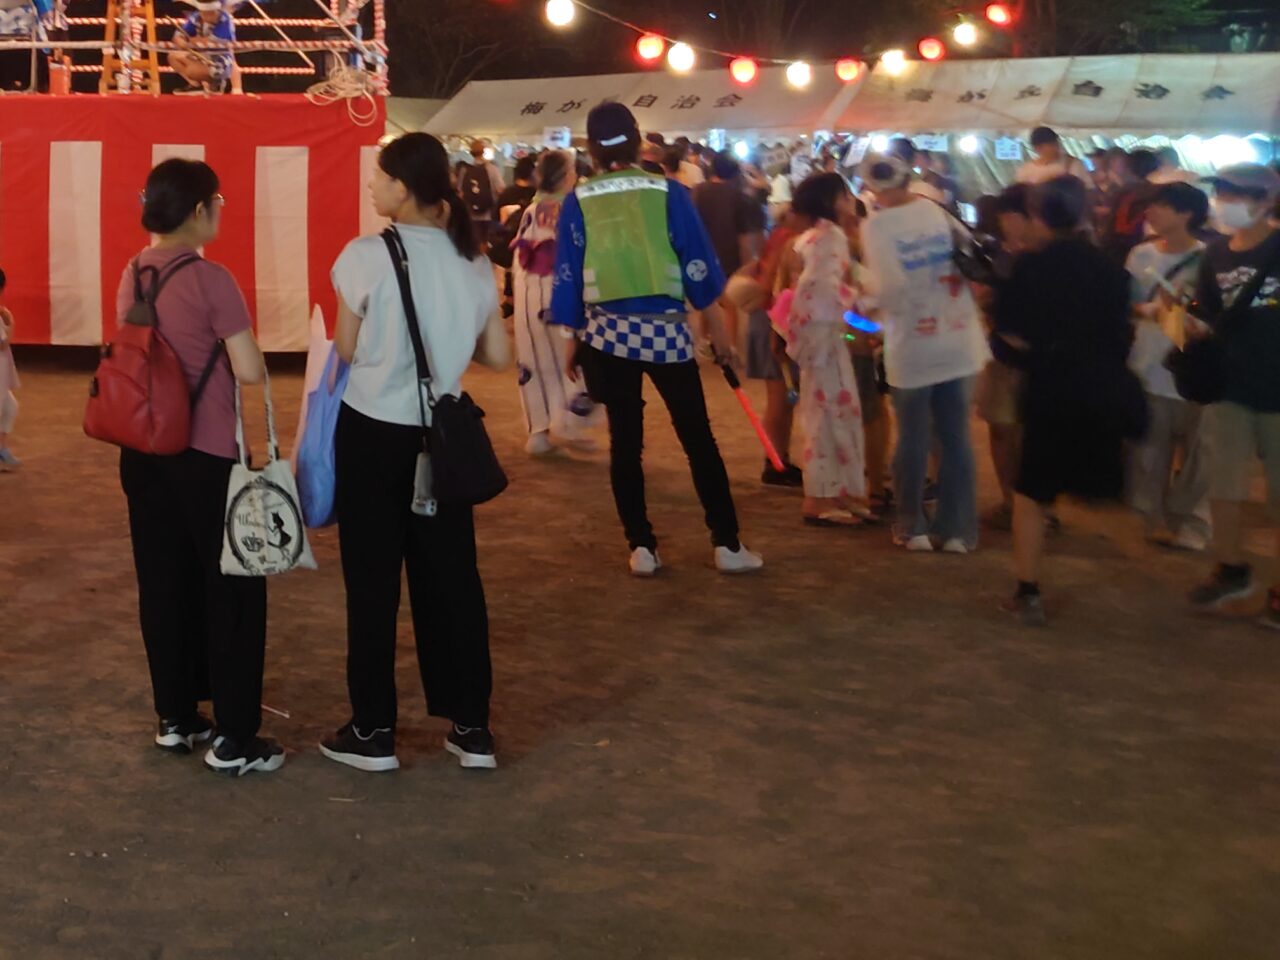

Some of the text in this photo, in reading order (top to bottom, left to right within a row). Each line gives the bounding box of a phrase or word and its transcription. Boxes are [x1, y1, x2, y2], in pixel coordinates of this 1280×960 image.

[520, 93, 744, 116] 梅が自治会
